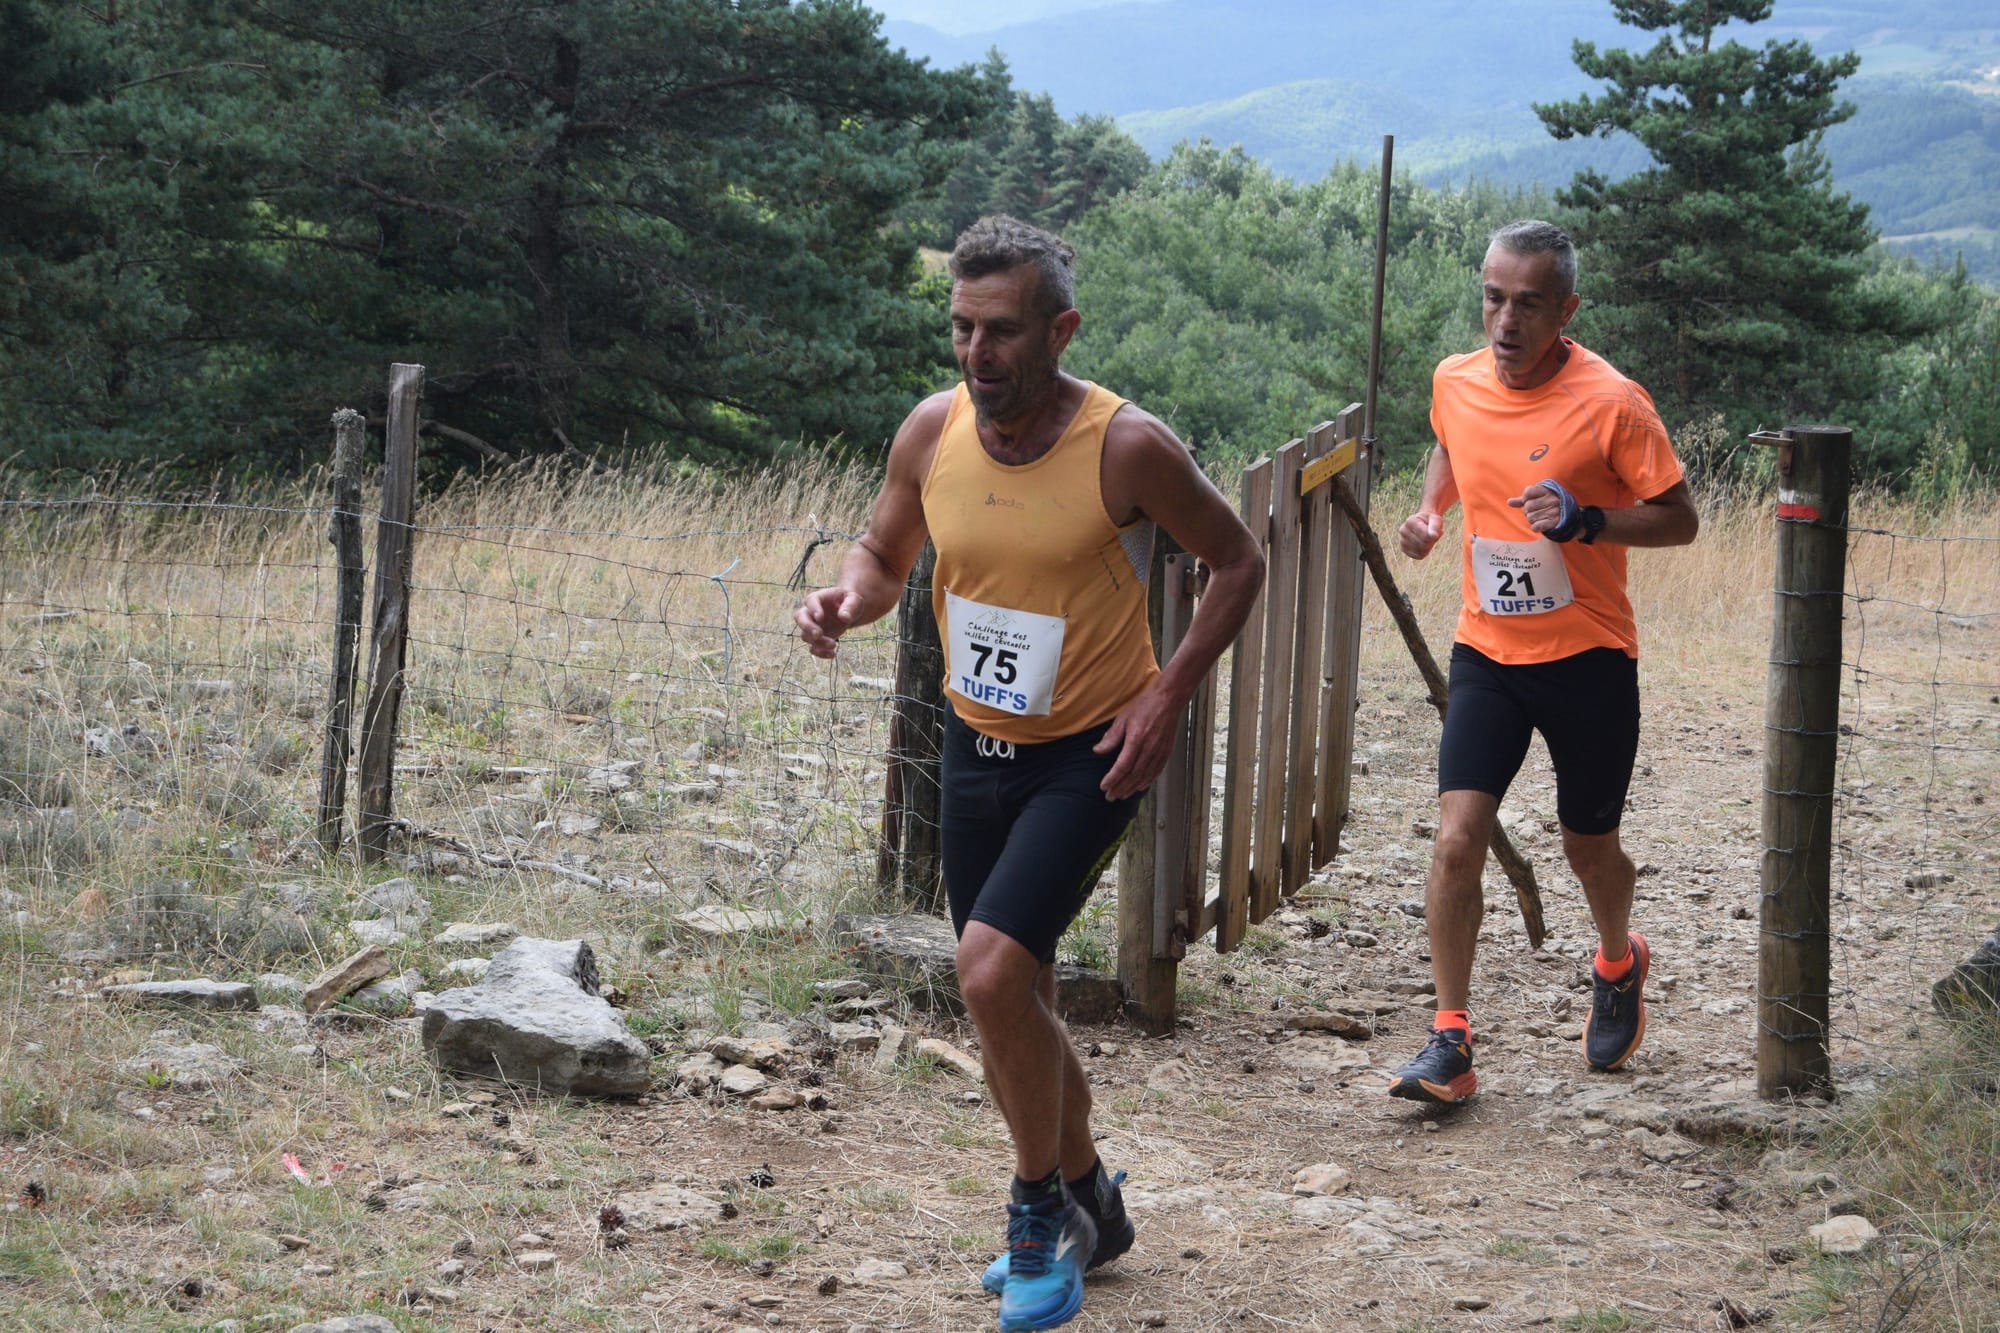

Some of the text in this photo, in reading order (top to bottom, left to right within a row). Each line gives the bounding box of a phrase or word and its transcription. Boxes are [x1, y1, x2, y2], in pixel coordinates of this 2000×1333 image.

[1491, 554, 1520, 563] Challenge
[1496, 570, 1535, 597] 21
[1490, 597, 1555, 612] TUFF'S
[964, 631, 990, 642] vallées
[968, 622, 1028, 641] Challenge des
[970, 642, 1018, 685] 75
[962, 676, 1028, 711] TUFF'S
